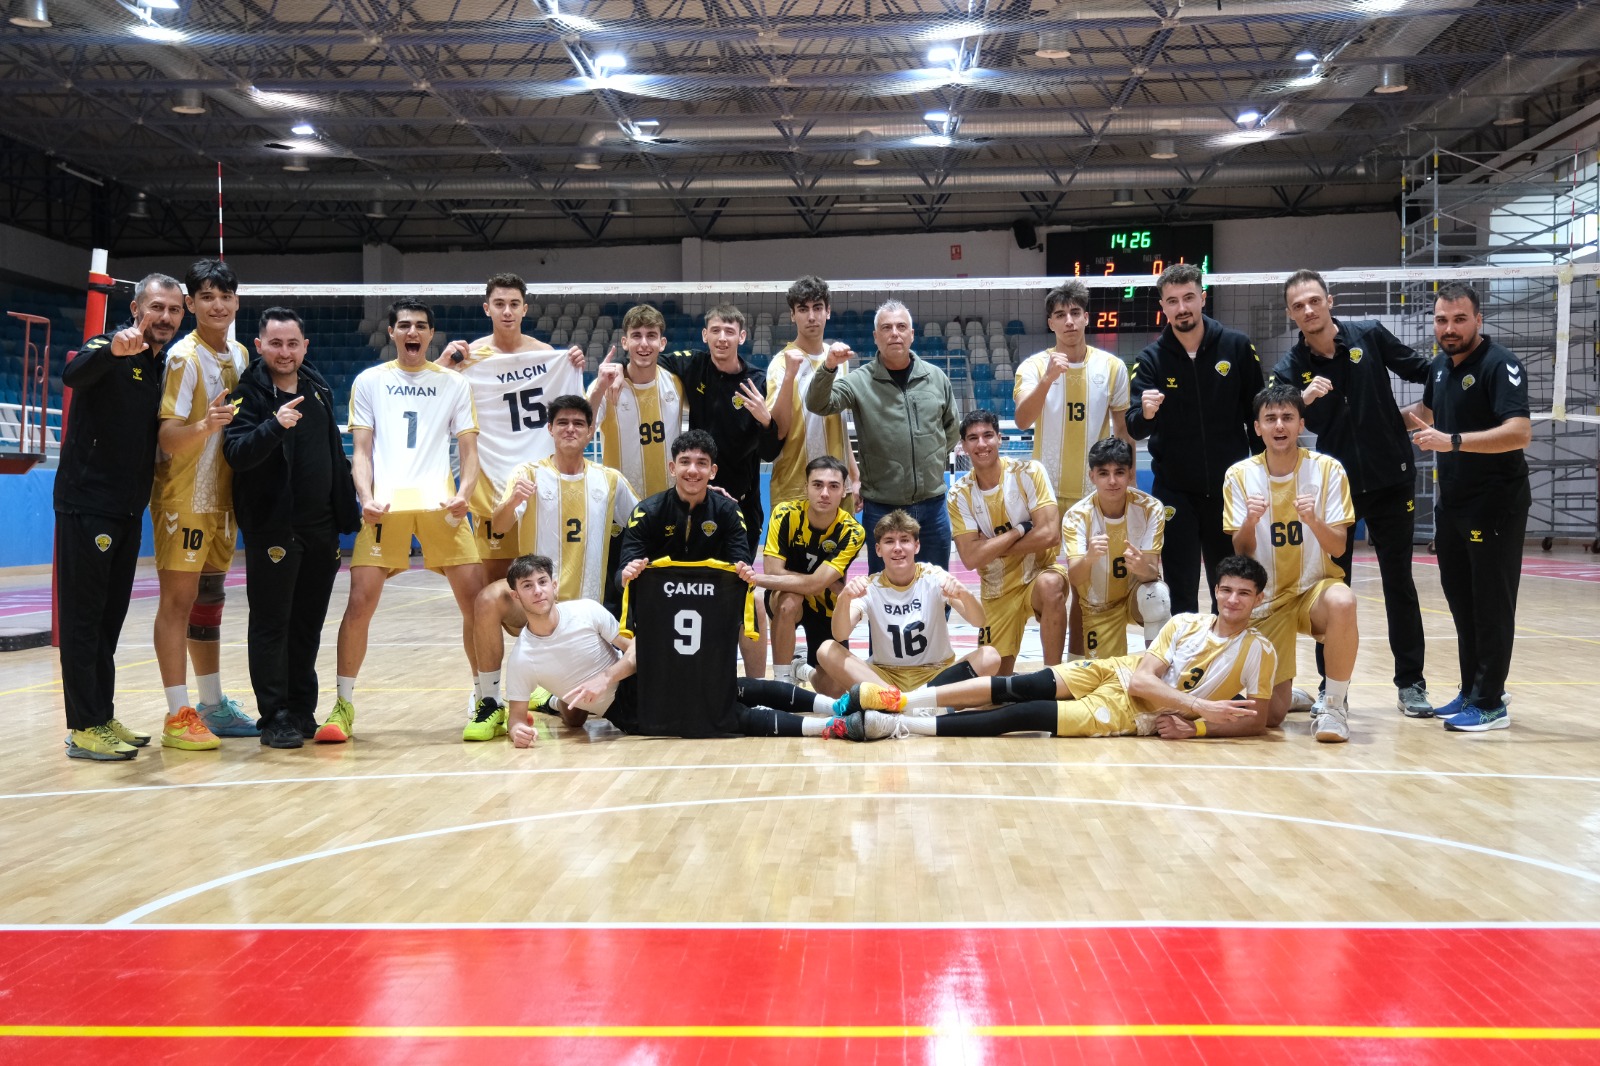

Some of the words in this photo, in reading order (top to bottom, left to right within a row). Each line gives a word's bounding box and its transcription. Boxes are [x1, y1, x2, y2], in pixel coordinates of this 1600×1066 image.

[1097, 311, 1118, 328] 25
[496, 363, 547, 384] YALÇIN
[386, 385, 437, 397] YAMAN
[503, 387, 548, 432] 15
[1067, 402, 1085, 421] 13
[403, 411, 418, 448] 1
[639, 421, 665, 445] 99
[182, 528, 203, 550] 10
[375, 523, 382, 543] 1
[567, 518, 582, 542] 2
[1270, 521, 1303, 547] 60
[806, 552, 818, 572] 7
[1113, 557, 1127, 578] 6
[663, 581, 715, 597] ÇAKIR
[884, 599, 921, 615] BARIŞ
[674, 610, 702, 655] 9
[887, 620, 927, 659] 16
[978, 626, 991, 645] 21
[1087, 631, 1098, 650] 6
[1184, 667, 1204, 690] 3
